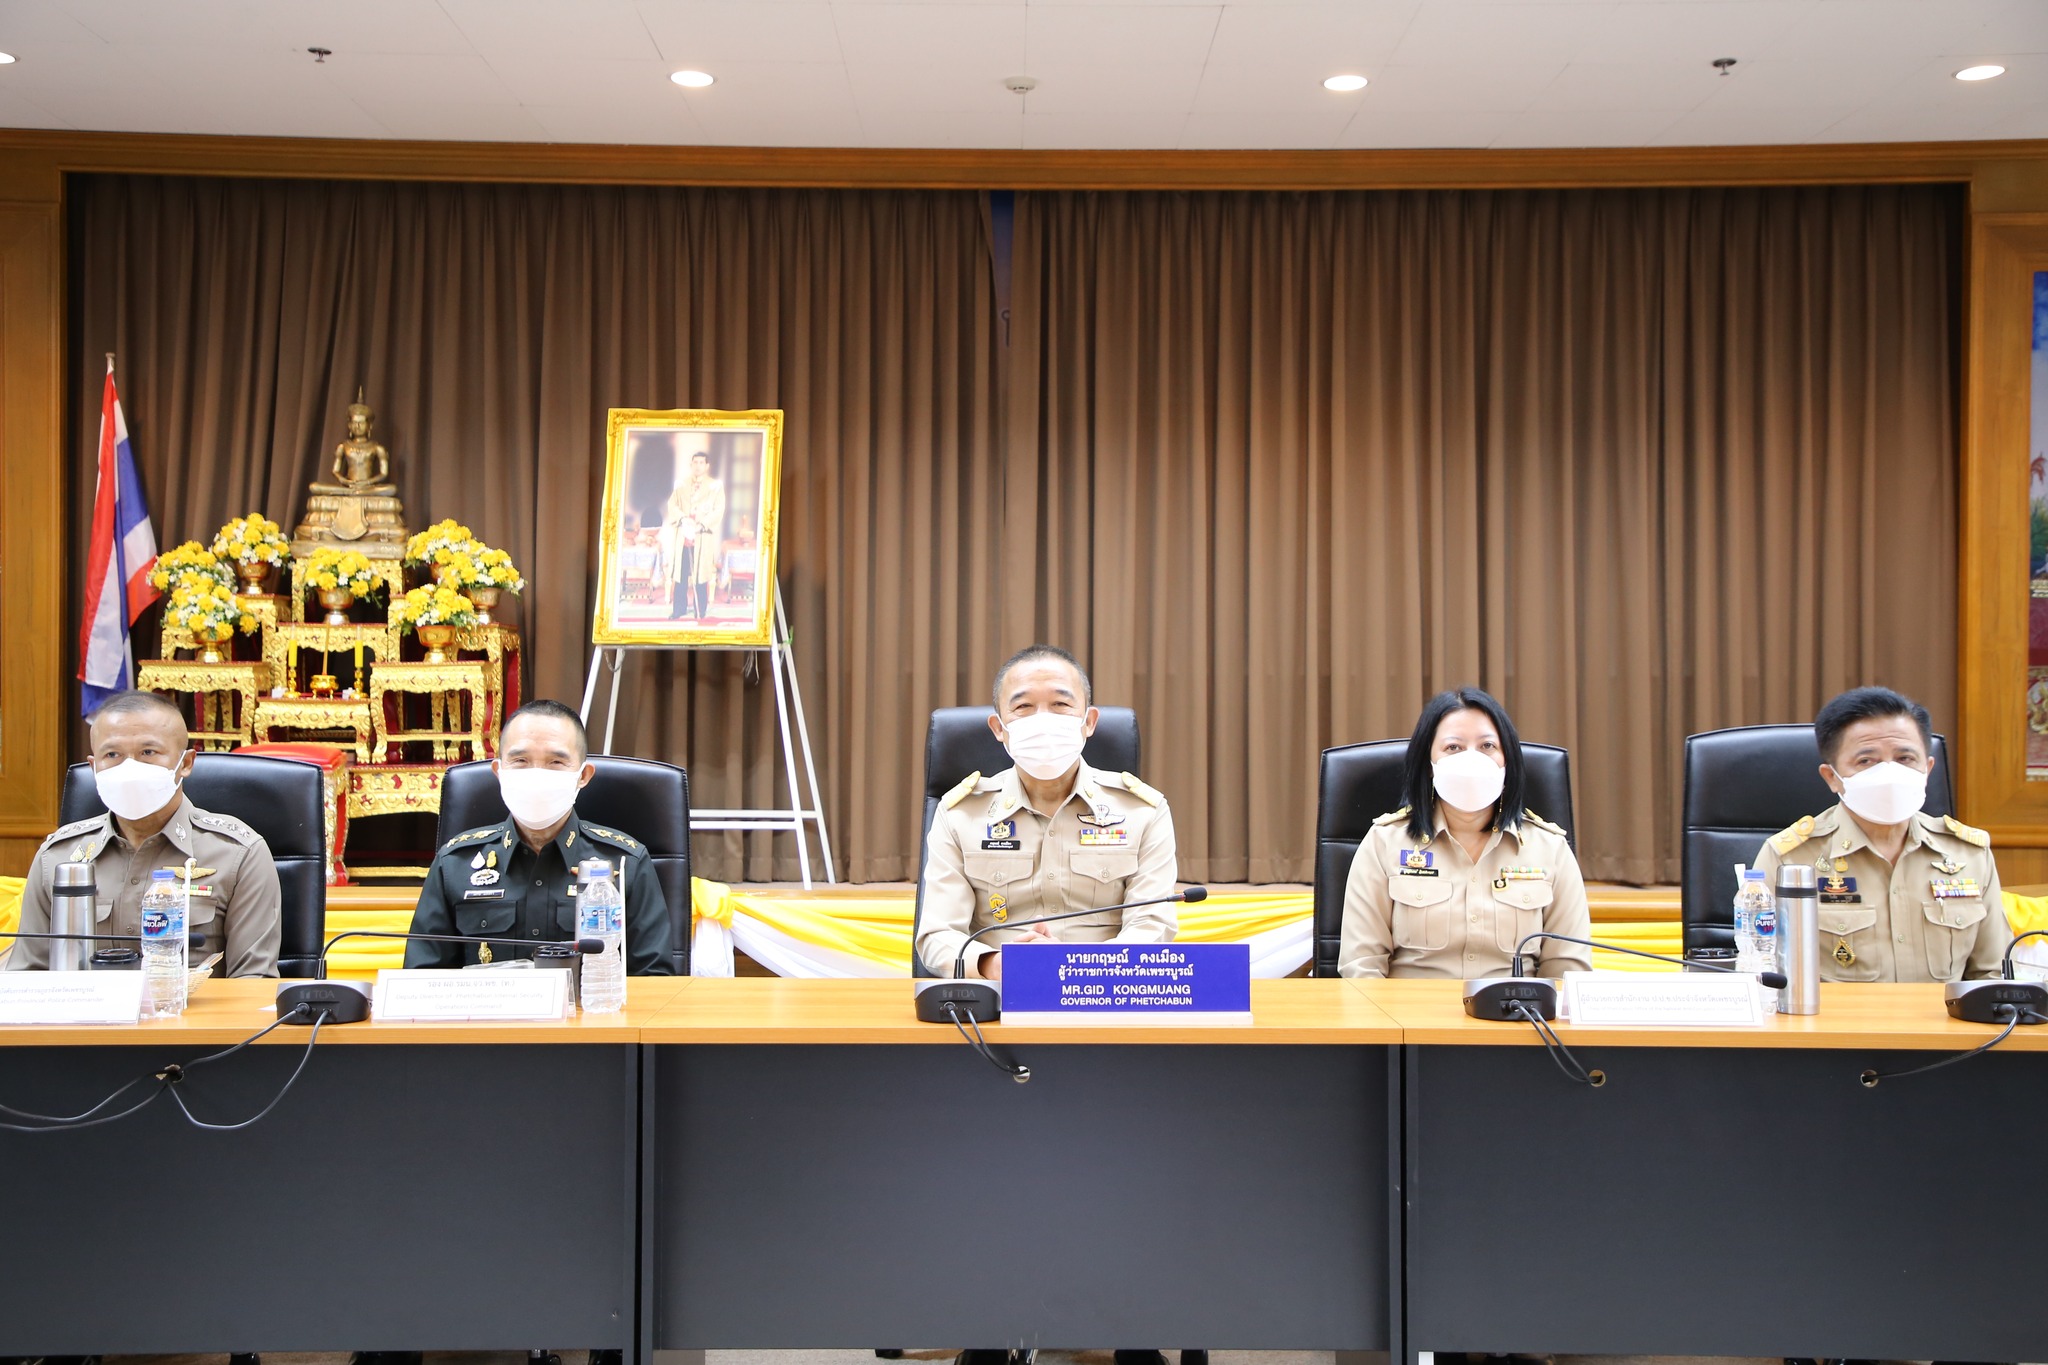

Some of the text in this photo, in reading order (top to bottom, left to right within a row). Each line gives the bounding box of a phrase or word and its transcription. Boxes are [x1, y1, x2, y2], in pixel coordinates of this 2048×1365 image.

[1755, 919, 1771, 927] Pure
[1066, 948, 1185, 966] นายกฤษณ์ คงเมือง
[1058, 963, 1194, 981] ผู้ว่าราชการจังหวัดเพชรบูรณ์
[313, 990, 335, 1000] TOA
[955, 989, 976, 999] TOA
[1061, 985, 1191, 996] MR.GID KONGMUANG
[1518, 987, 1538, 997] TOA
[2011, 989, 2032, 999] TOA
[1060, 997, 1192, 1006] GOVERNOR OF PHETCHABUN
